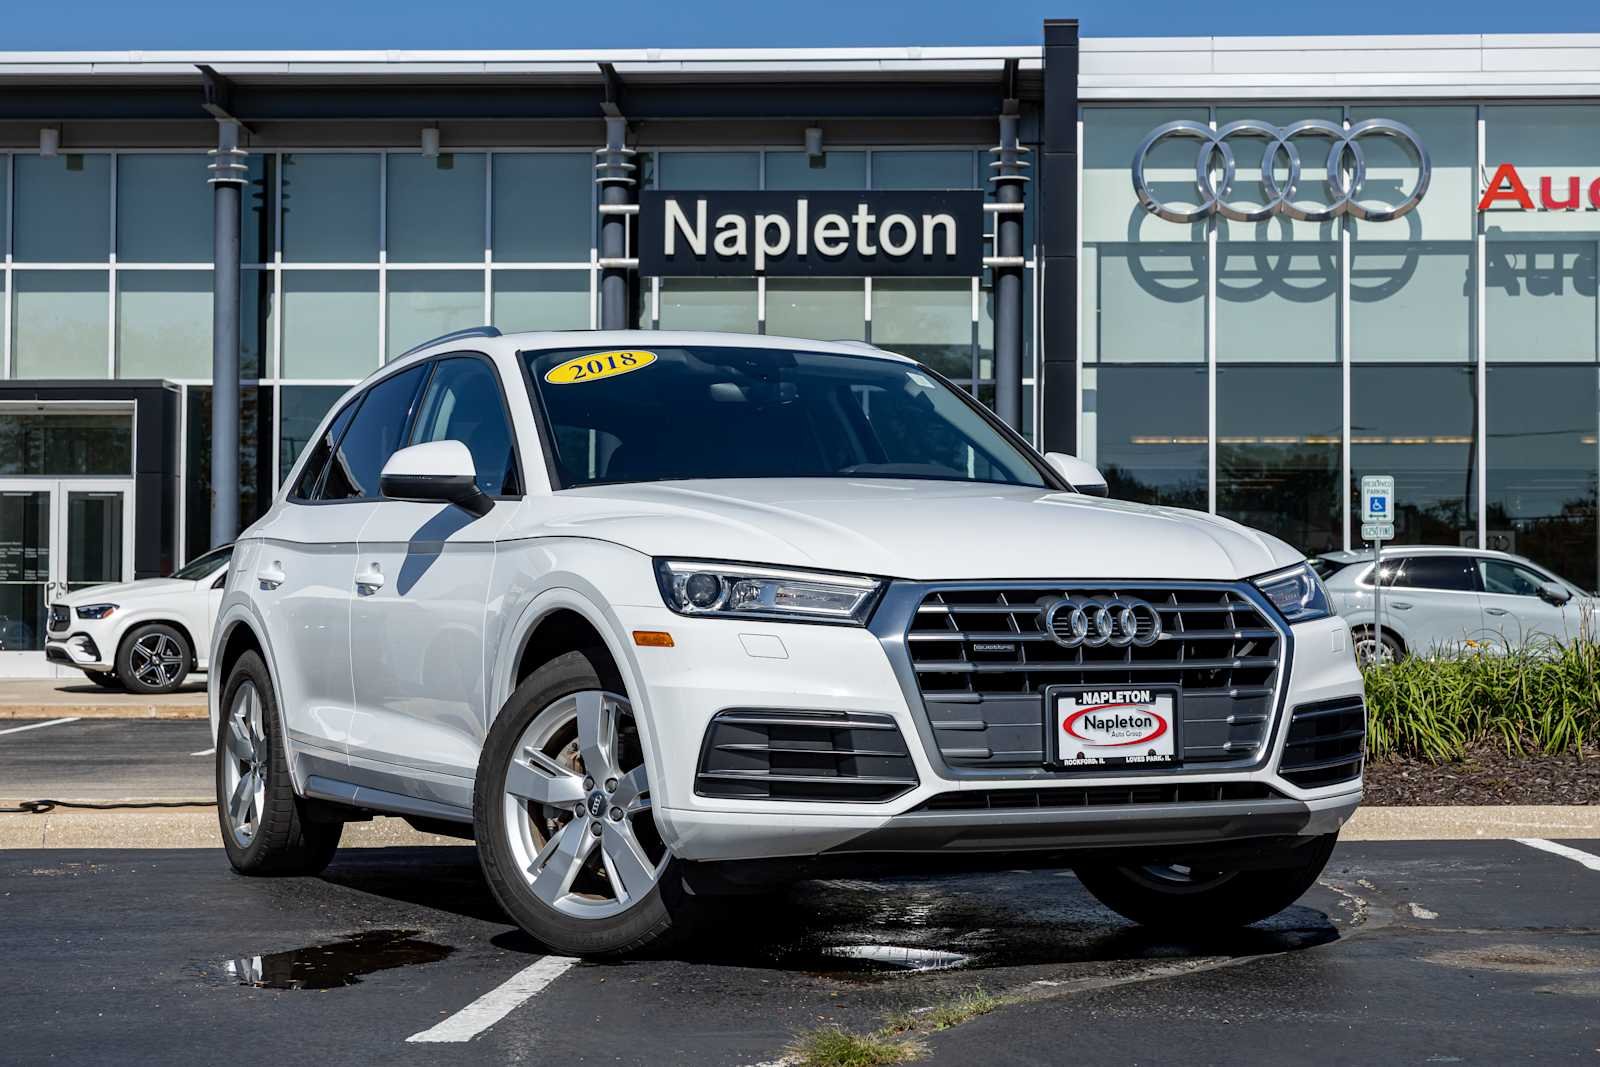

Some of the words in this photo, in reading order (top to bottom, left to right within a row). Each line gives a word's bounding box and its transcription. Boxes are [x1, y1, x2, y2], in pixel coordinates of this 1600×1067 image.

[664, 200, 956, 271] Napleton
[569, 353, 637, 379] 2018
[1082, 690, 1151, 704] NAPLETON
[1084, 714, 1152, 732] Napleton
